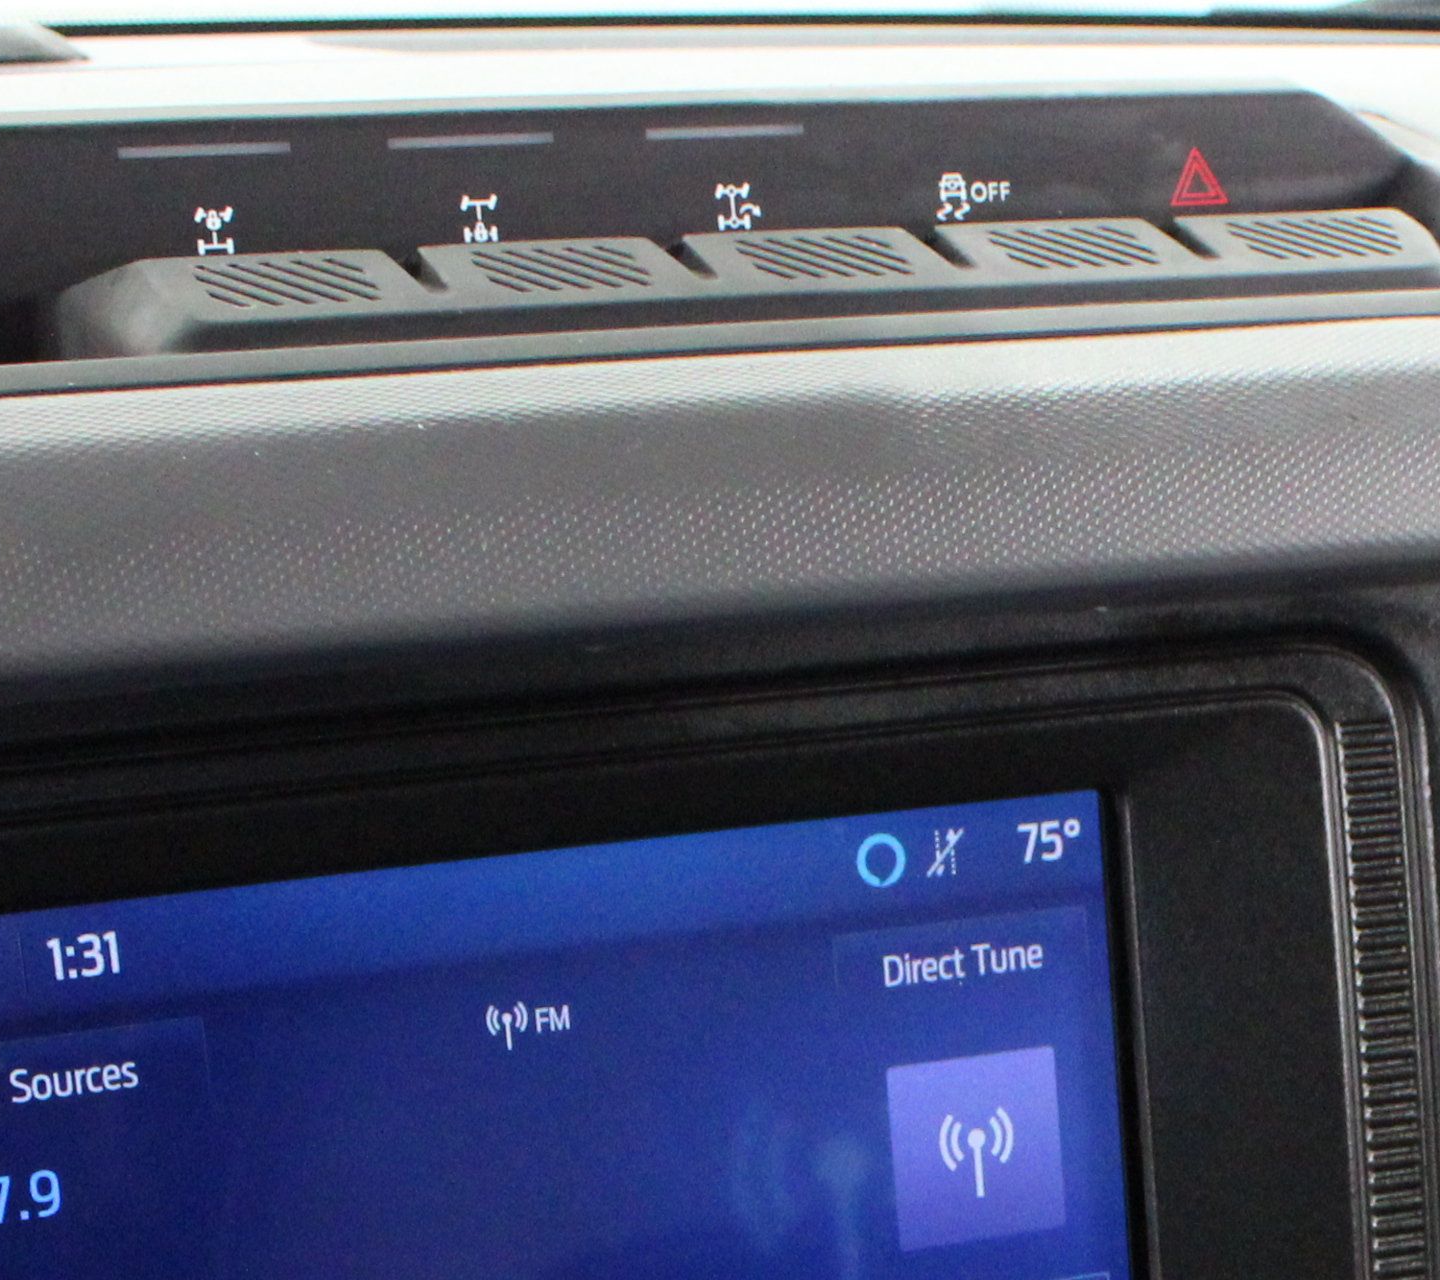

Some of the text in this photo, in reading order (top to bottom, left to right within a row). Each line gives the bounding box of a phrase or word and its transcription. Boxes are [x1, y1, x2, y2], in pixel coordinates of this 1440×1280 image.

[970, 180, 1011, 203] OFF
[1017, 819, 1080, 864] 75°
[47, 932, 120, 980] 1:31
[883, 944, 1043, 987] Direct Tune
[535, 1005, 570, 1033] FM
[10, 1062, 138, 1103] Sources
